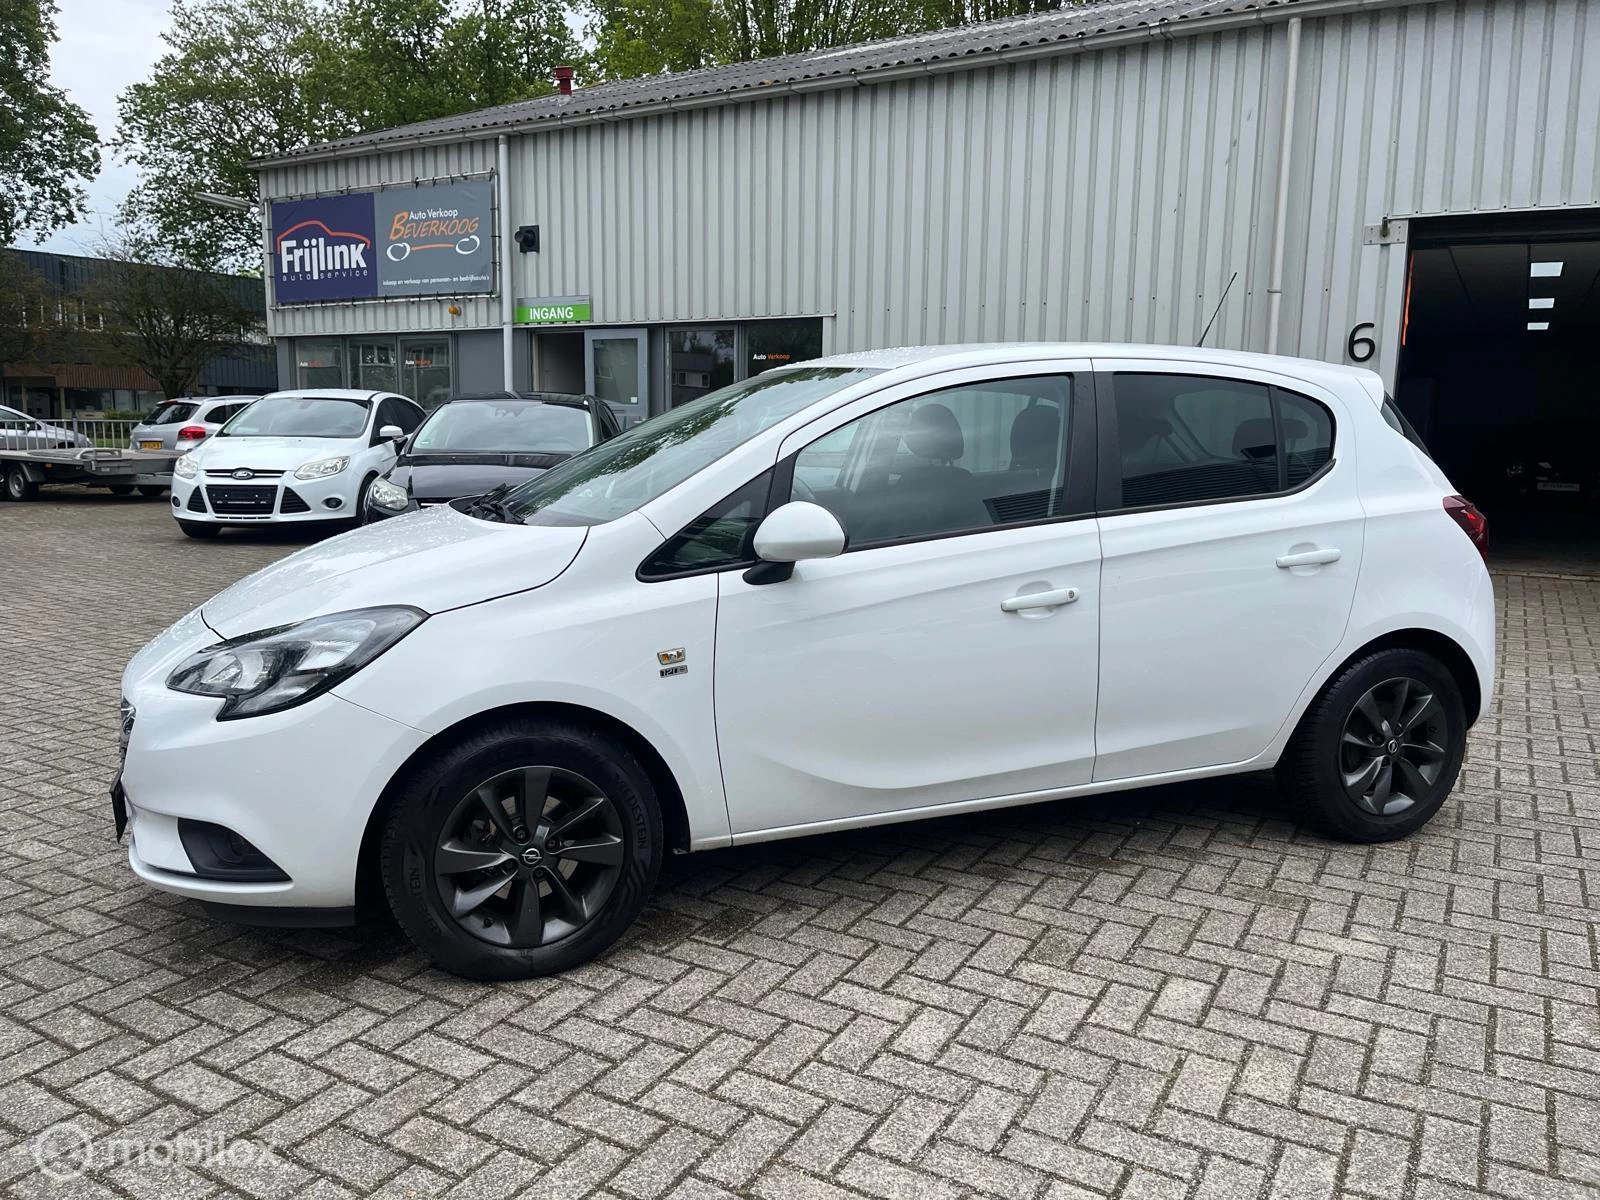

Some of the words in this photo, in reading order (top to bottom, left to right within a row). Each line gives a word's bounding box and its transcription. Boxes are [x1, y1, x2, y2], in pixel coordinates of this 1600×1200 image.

[389, 211, 480, 241] BEVERKOOG
[409, 211, 426, 220] Auto
[427, 208, 458, 219] Verkoop
[281, 237, 367, 280] Frijlink
[529, 307, 574, 320] INGANG
[1348, 322, 1376, 362] 6
